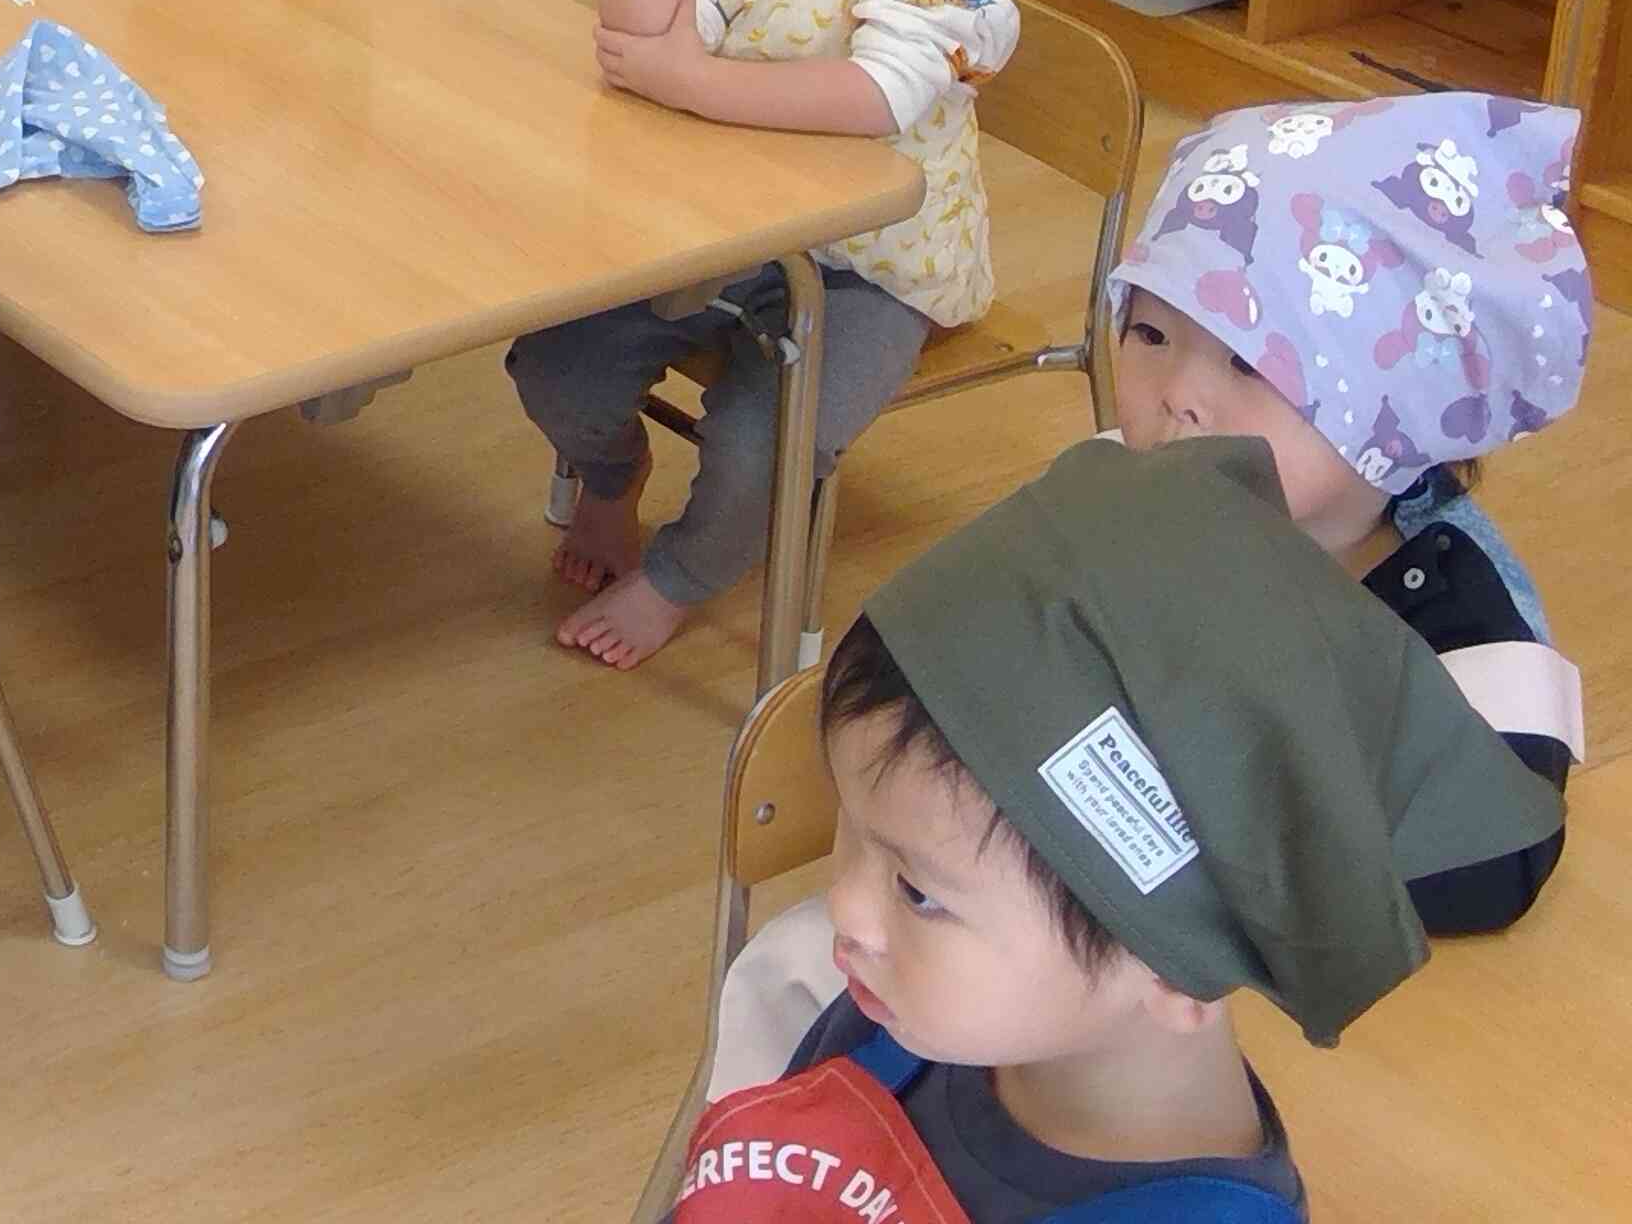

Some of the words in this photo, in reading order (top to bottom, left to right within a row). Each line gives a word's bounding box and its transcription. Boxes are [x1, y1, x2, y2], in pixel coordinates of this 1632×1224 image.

[1067, 770, 1087, 795] with
[1084, 795, 1109, 816] your
[1106, 816, 1134, 844] loved
[1078, 759, 1109, 794] Spend
[1104, 794, 1142, 834] peaceful
[1141, 833, 1164, 857] days
[1098, 733, 1173, 814] Peaceful
[678, 1141, 841, 1201] ERFECT
